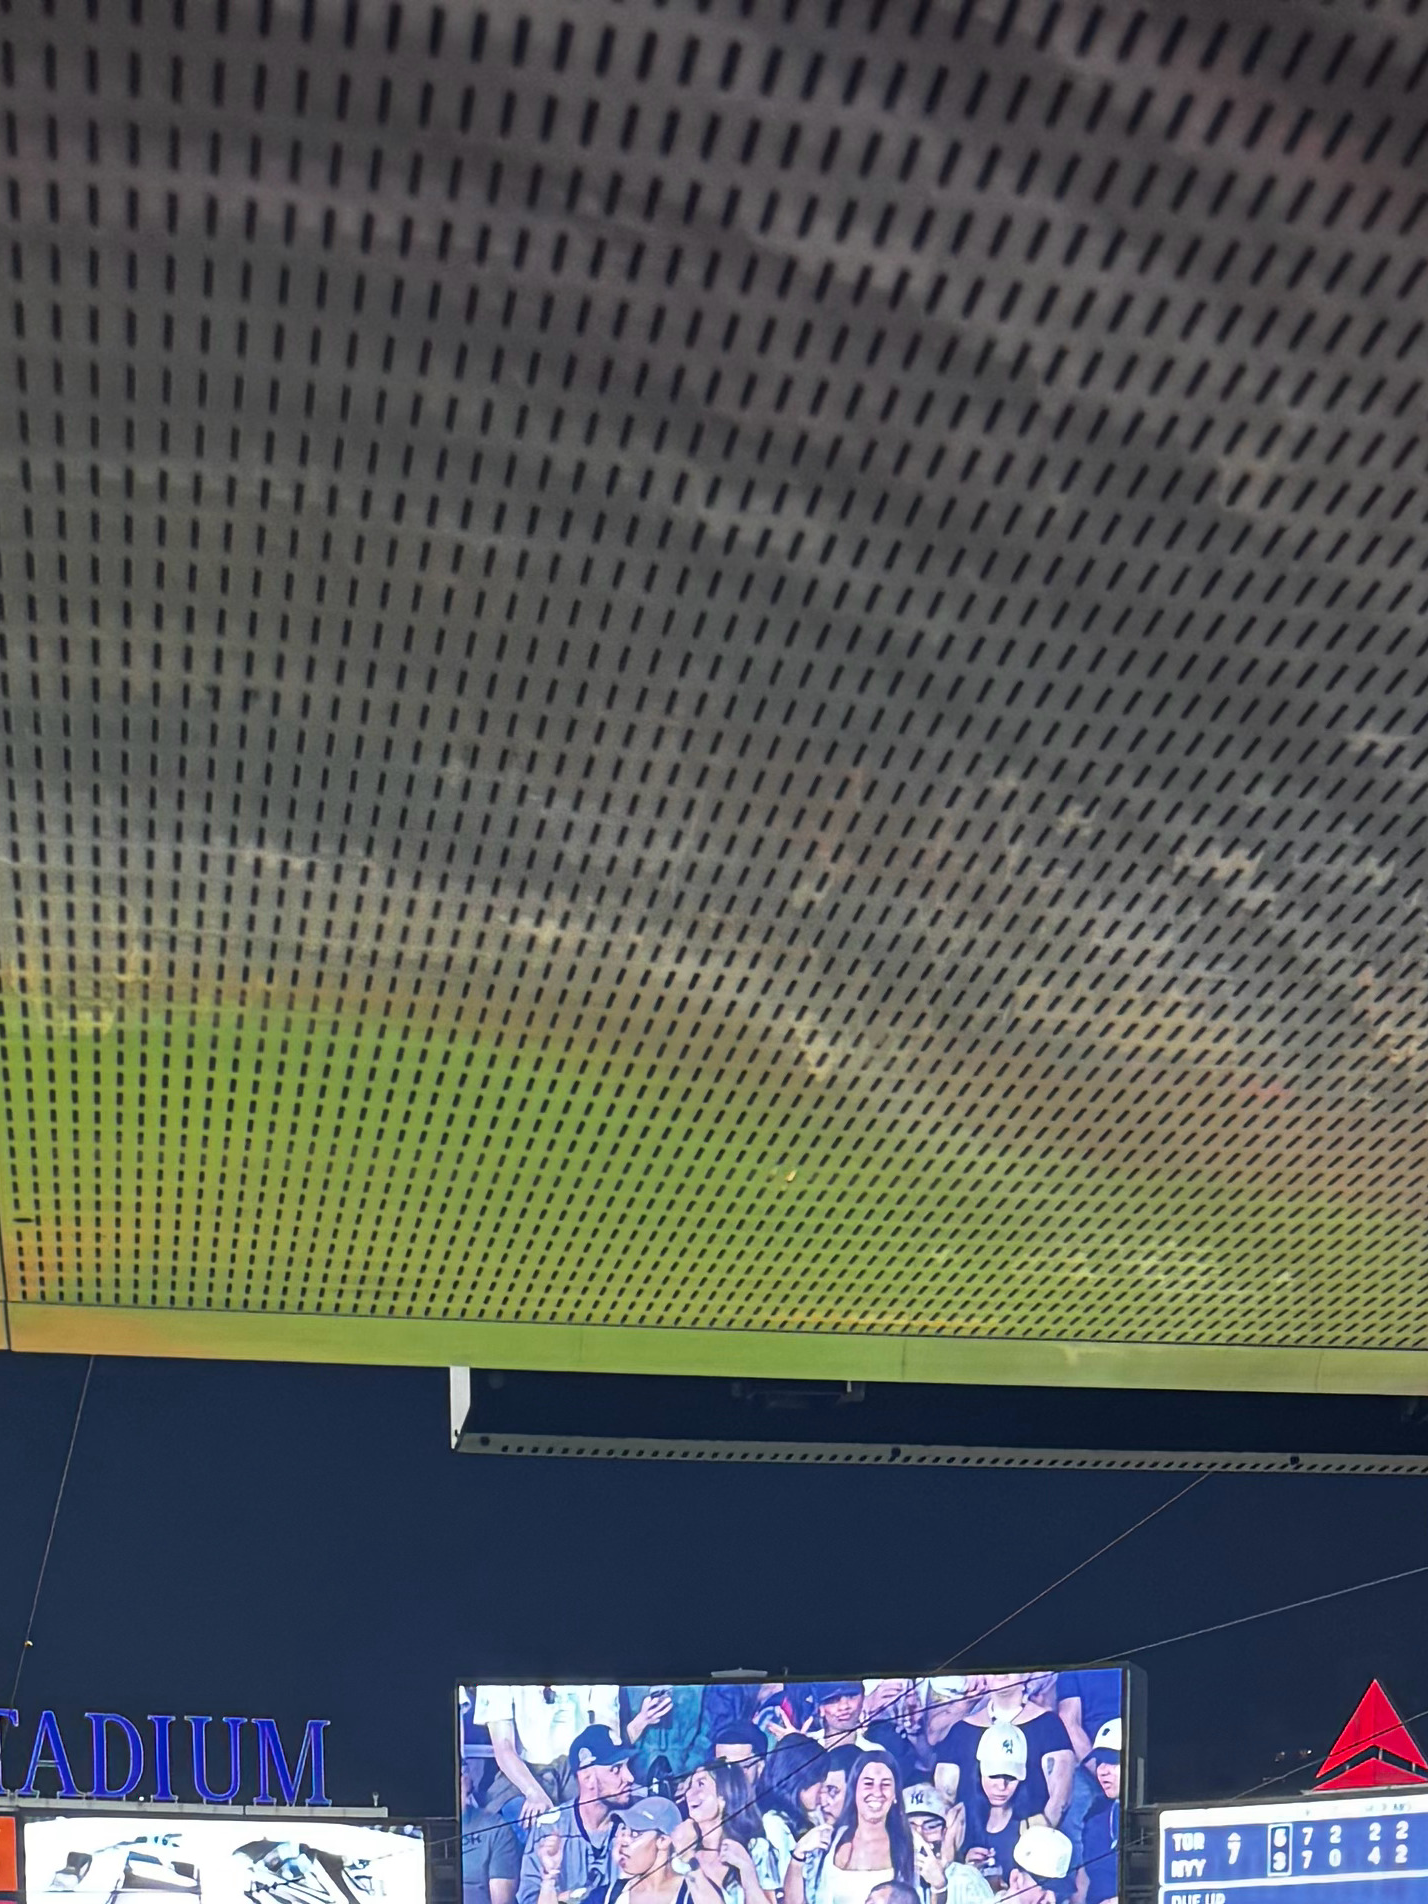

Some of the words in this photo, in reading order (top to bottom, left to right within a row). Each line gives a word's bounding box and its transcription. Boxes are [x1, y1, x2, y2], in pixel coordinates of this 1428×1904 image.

[1302, 1827, 1314, 1845] 7
[1329, 1825, 1342, 1844] 2
[1369, 1822, 1381, 1842] 2
[1395, 1821, 1408, 1840] 2
[1301, 1850, 1313, 1870] 7
[1329, 1848, 1341, 1867] 0
[1368, 1845, 1381, 1864] 4
[1395, 1844, 1408, 1863] 2
